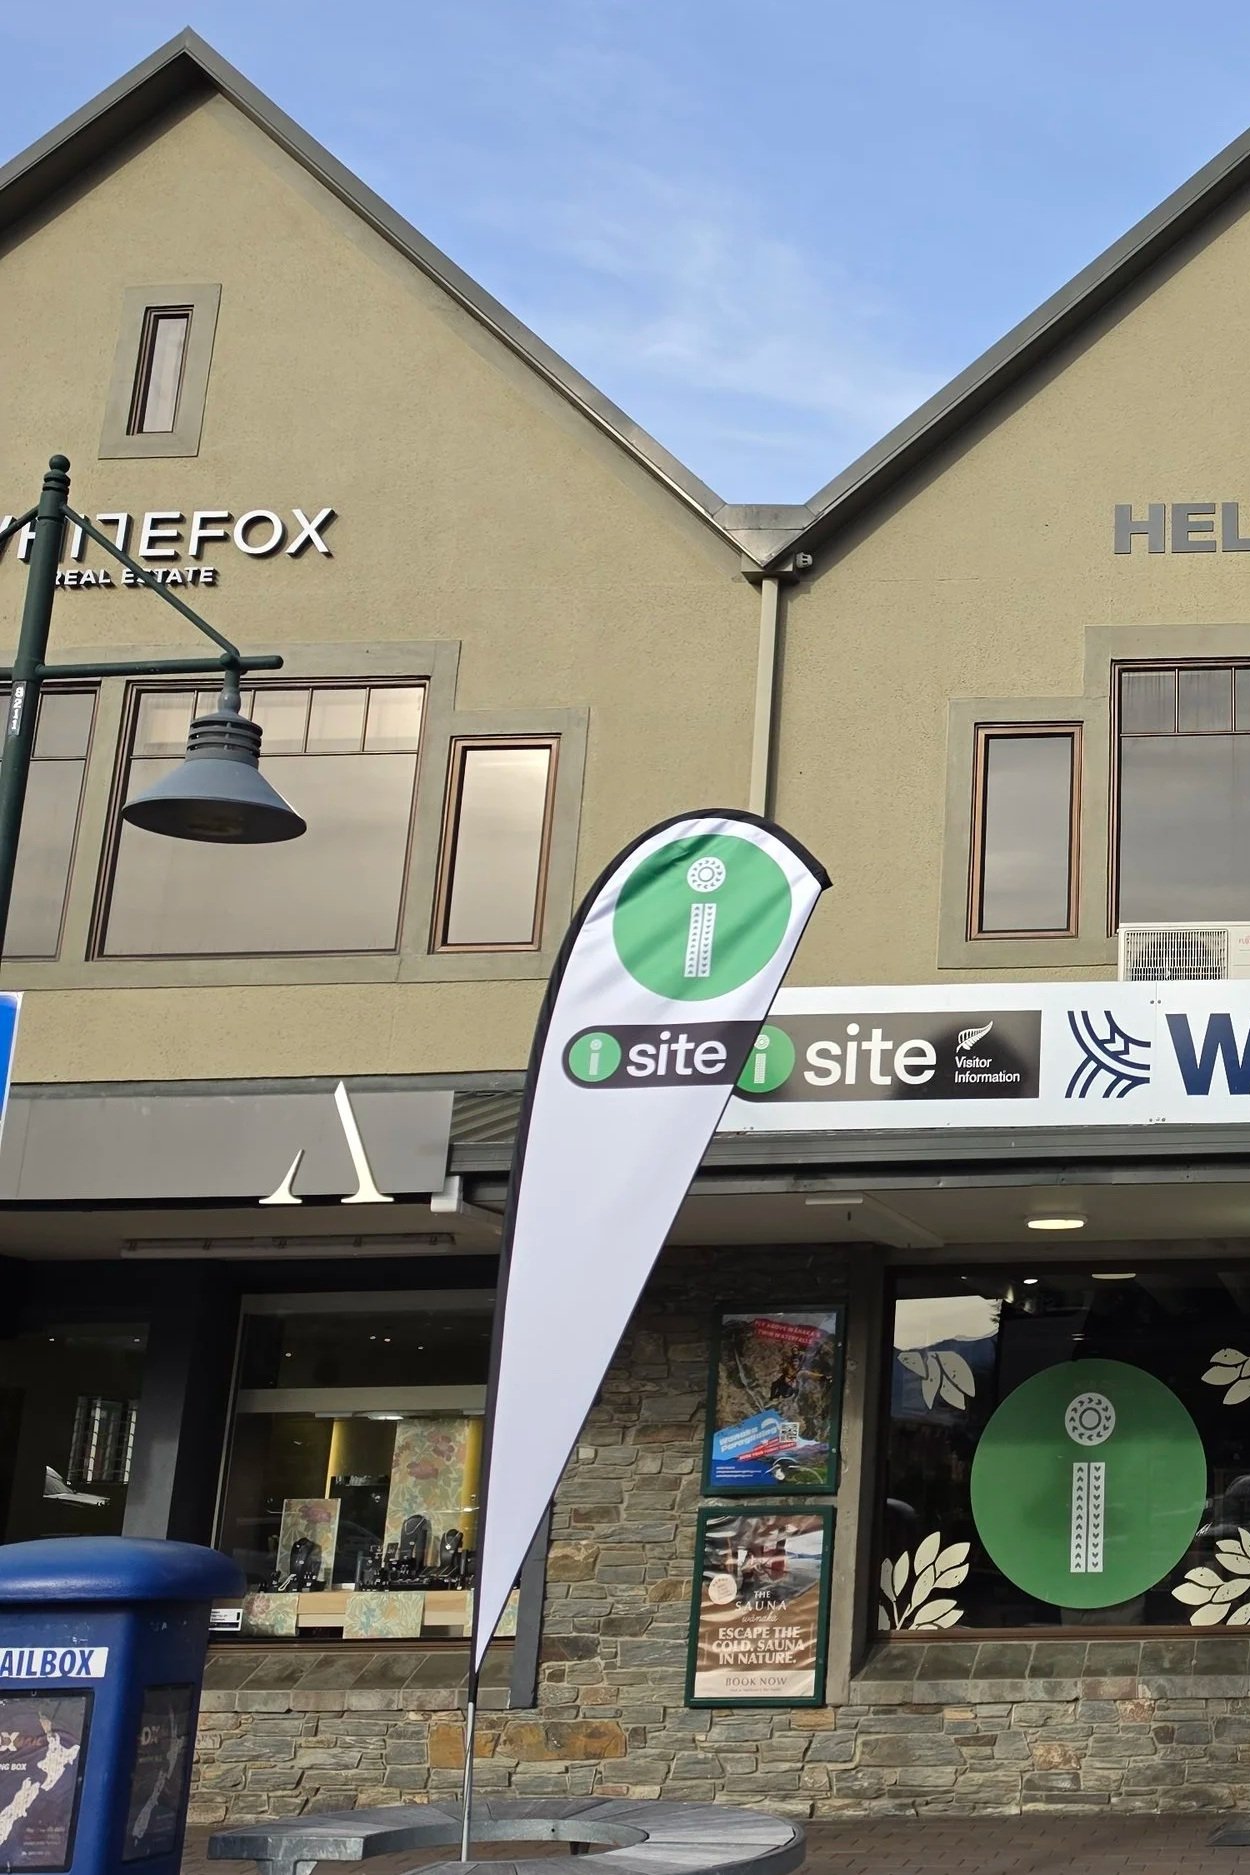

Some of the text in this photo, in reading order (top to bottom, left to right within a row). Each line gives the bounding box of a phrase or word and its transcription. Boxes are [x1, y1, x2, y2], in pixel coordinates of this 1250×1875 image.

[11, 686, 24, 730] 8211
[626, 1030, 728, 1077] site
[803, 1022, 937, 1087] site
[954, 1055, 993, 1069] Visitor
[954, 1069, 1021, 1084] Information
[753, 1590, 771, 1599] THE
[735, 1600, 788, 1612] SAUNA
[718, 1625, 801, 1640] ESCAPE THE
[757, 1638, 805, 1652] SAUNA
[0, 1649, 95, 1677] AILBOX
[719, 1651, 797, 1665] IN NATURE.
[725, 1676, 788, 1687] BOOK NOW
[11, 1763, 27, 1771] BOX
